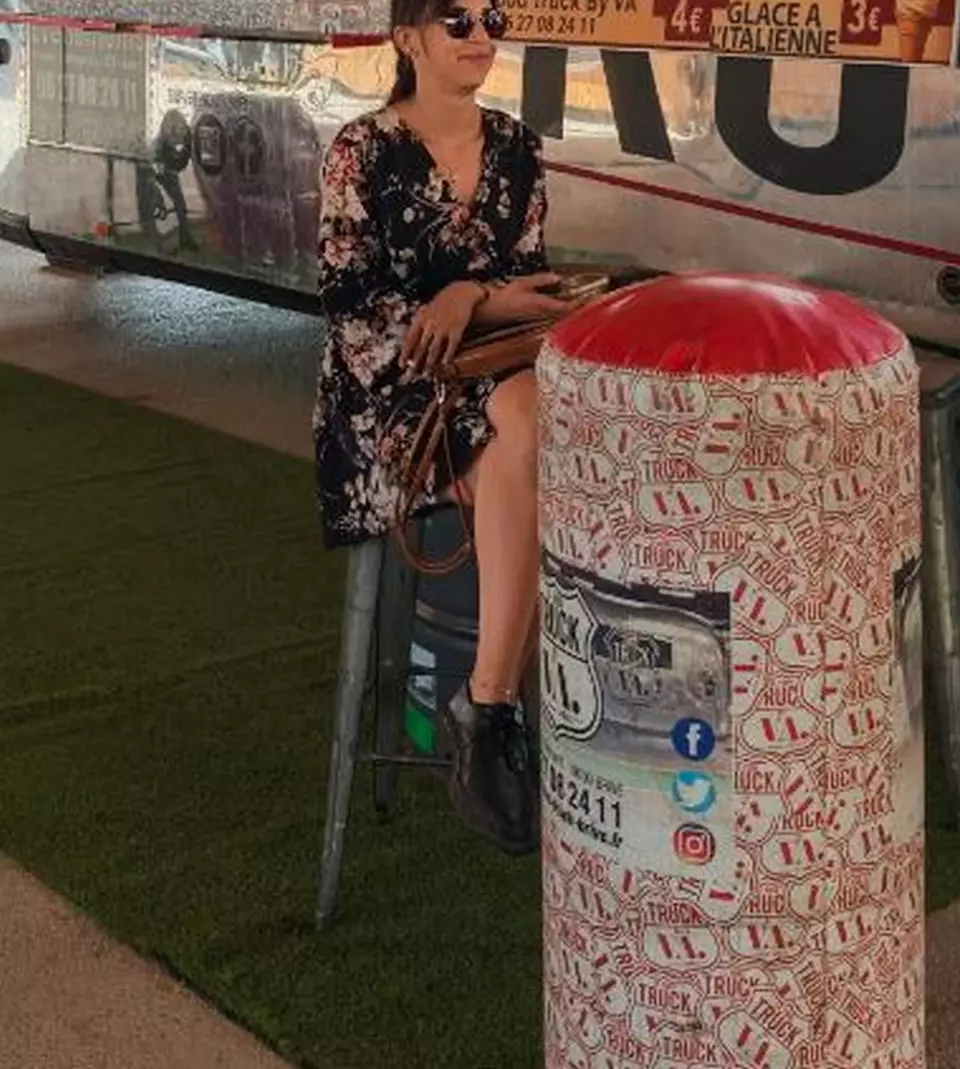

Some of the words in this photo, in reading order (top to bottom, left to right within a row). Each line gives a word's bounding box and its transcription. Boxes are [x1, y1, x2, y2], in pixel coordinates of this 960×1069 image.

[516, 14, 533, 31] 27
[537, 15, 554, 33] 08
[558, 16, 574, 33] 24
[581, 17, 595, 34] 11
[727, 1, 799, 26] GLACE
[805, 2, 821, 27] A
[709, 26, 837, 54] L'ITALIENNE
[634, 543, 686, 570] TRUCK
[748, 551, 796, 601] TRUCK
[635, 983, 691, 1013] TRUCK
[751, 998, 801, 1048] TRUCK
